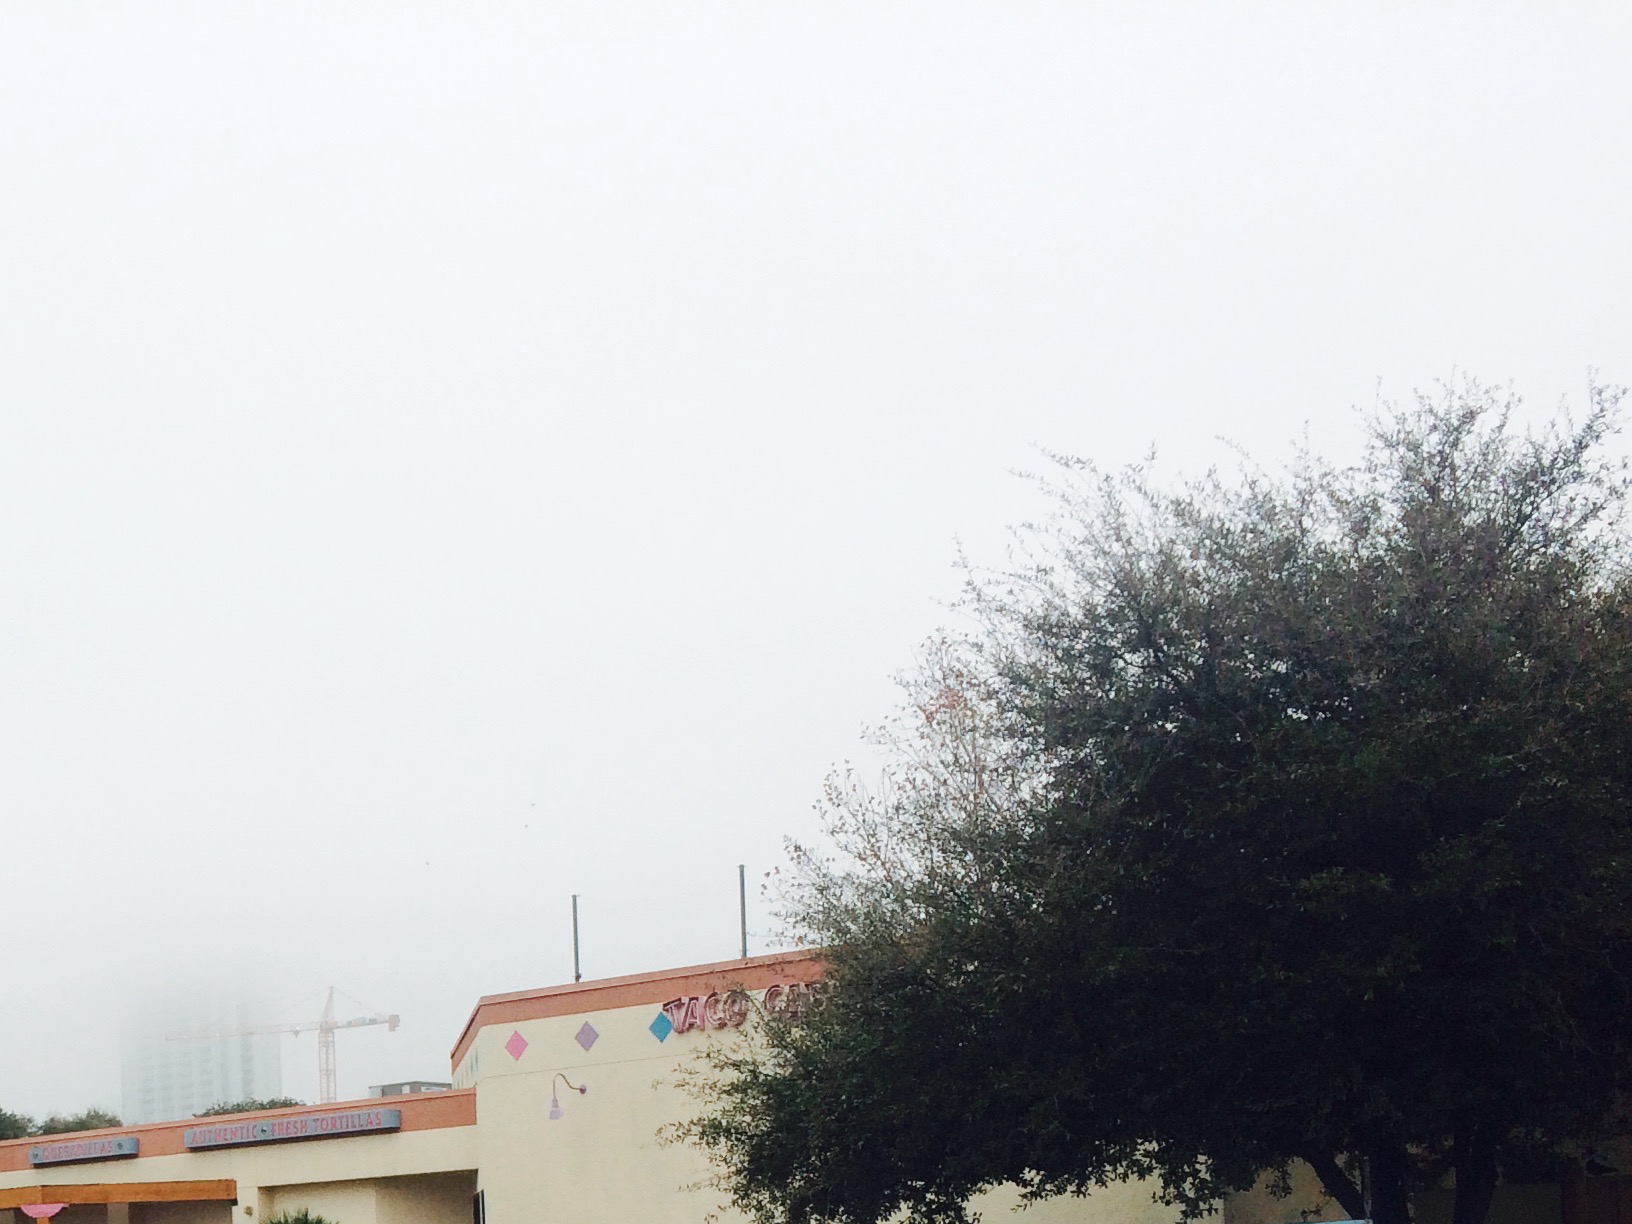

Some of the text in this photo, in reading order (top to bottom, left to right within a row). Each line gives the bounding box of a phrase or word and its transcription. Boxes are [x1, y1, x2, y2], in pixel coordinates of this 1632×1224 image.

[662, 991, 749, 1033] TACO
[190, 1111, 383, 1145] AUTHENTIC FRESH TORTILLAS
